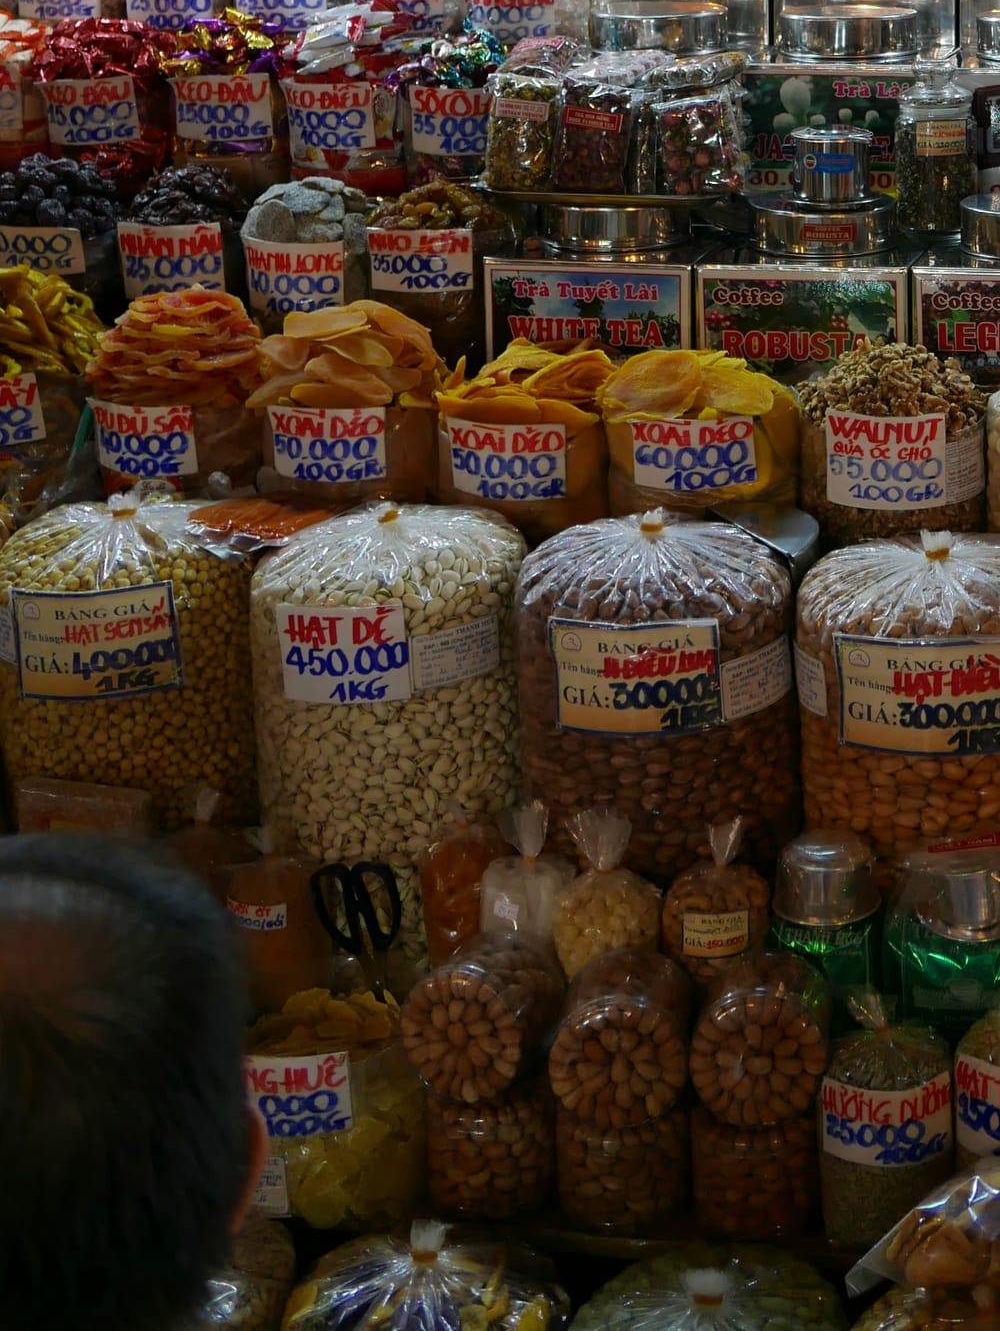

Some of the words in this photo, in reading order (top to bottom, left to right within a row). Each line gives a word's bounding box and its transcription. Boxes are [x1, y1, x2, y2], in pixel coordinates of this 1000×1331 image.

[833, 80, 873, 99] Trà
[806, 231, 849, 239] ROBUSTA
[400, 271, 472, 289] 100G
[513, 280, 551, 297] Trà
[556, 279, 619, 303] Tuyết
[625, 281, 659, 302] Lài
[712, 286, 783, 307] Coffee
[606, 318, 664, 348] TEA
[275, 435, 378, 461] 50.000
[664, 466, 757, 491] 100G
[55, 608, 109, 623] BẢNG
[113, 599, 149, 619] GIÁ
[286, 614, 344, 656] HẠT
[658, 634, 695, 652] GIÁ
[25, 652, 70, 675] GIÁ:
[286, 640, 409, 677] 450.000
[561, 660, 578, 674] Tên
[887, 657, 945, 672] BẢNG
[330, 679, 389, 703] 1KG
[847, 676, 866, 688] Tên
[562, 685, 610, 710] GIÁ:
[848, 702, 899, 727] GIÁ:
